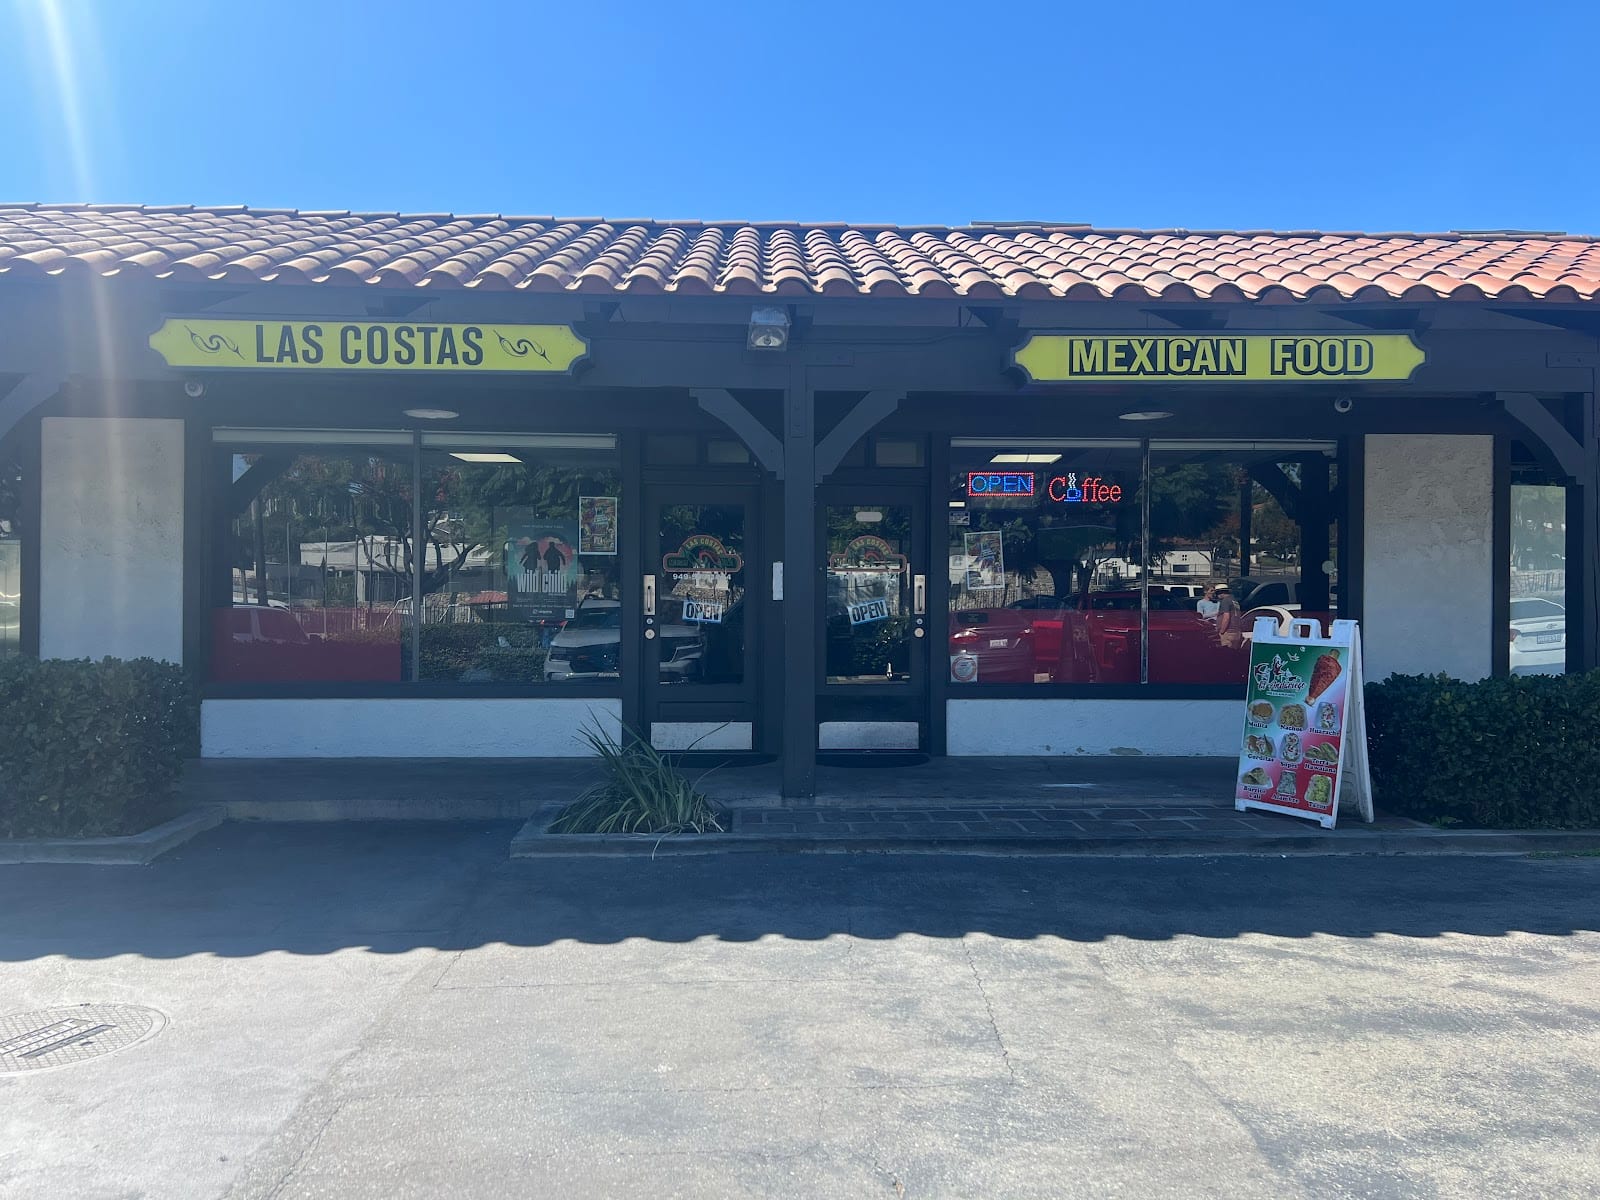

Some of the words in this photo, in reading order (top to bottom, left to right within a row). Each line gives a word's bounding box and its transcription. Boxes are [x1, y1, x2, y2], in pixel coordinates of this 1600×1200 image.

[255, 323, 324, 363] LAS
[339, 325, 484, 366] COSTAS
[1069, 338, 1247, 376] MEXICAN
[1270, 338, 1374, 376] FOOD
[971, 475, 1032, 493] OPEN
[685, 538, 699, 549] LAS
[517, 569, 539, 593] wild
[541, 569, 567, 593] child
[851, 601, 884, 622] OPEN
